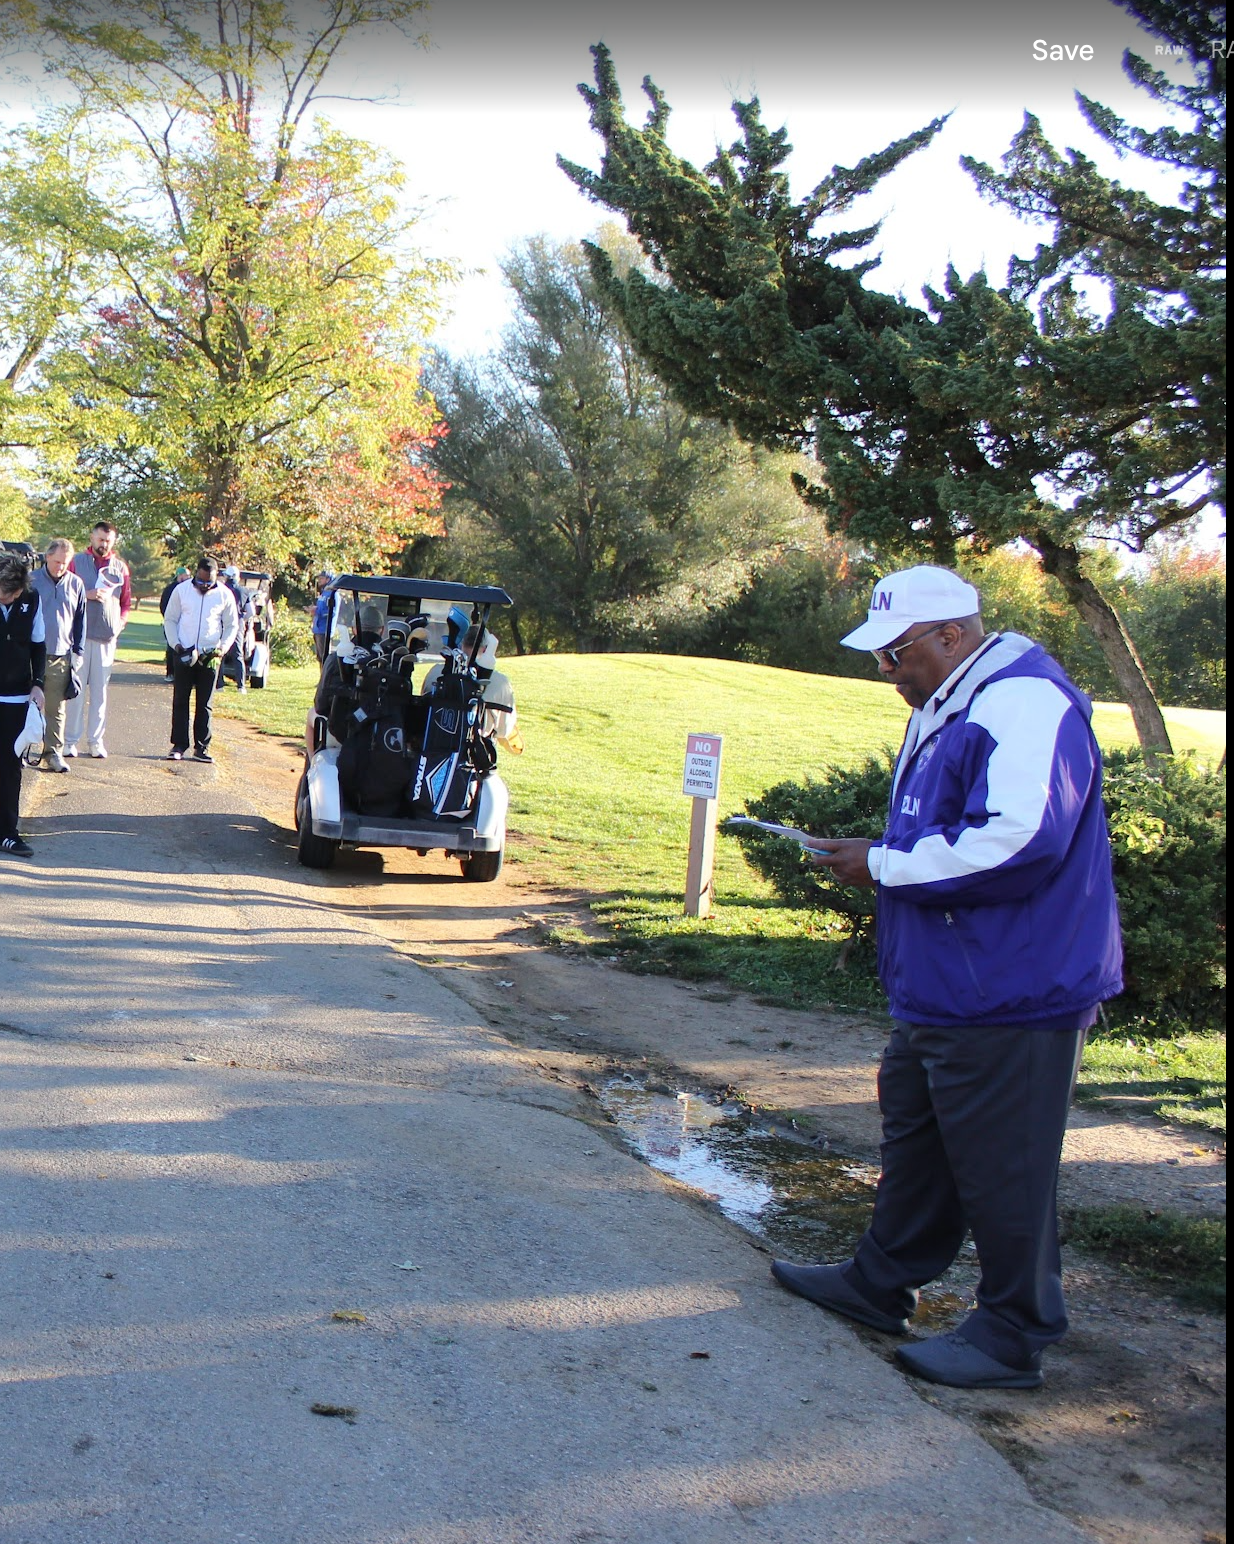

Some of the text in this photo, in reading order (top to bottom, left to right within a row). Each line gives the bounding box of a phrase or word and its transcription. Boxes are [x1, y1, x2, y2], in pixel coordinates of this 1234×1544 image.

[695, 741, 711, 753] NO
[691, 758, 712, 767] OUTSIDE
[412, 755, 427, 801] STRATA
[689, 768, 712, 778] ALCOHOL
[686, 778, 713, 789] PERMITTED
